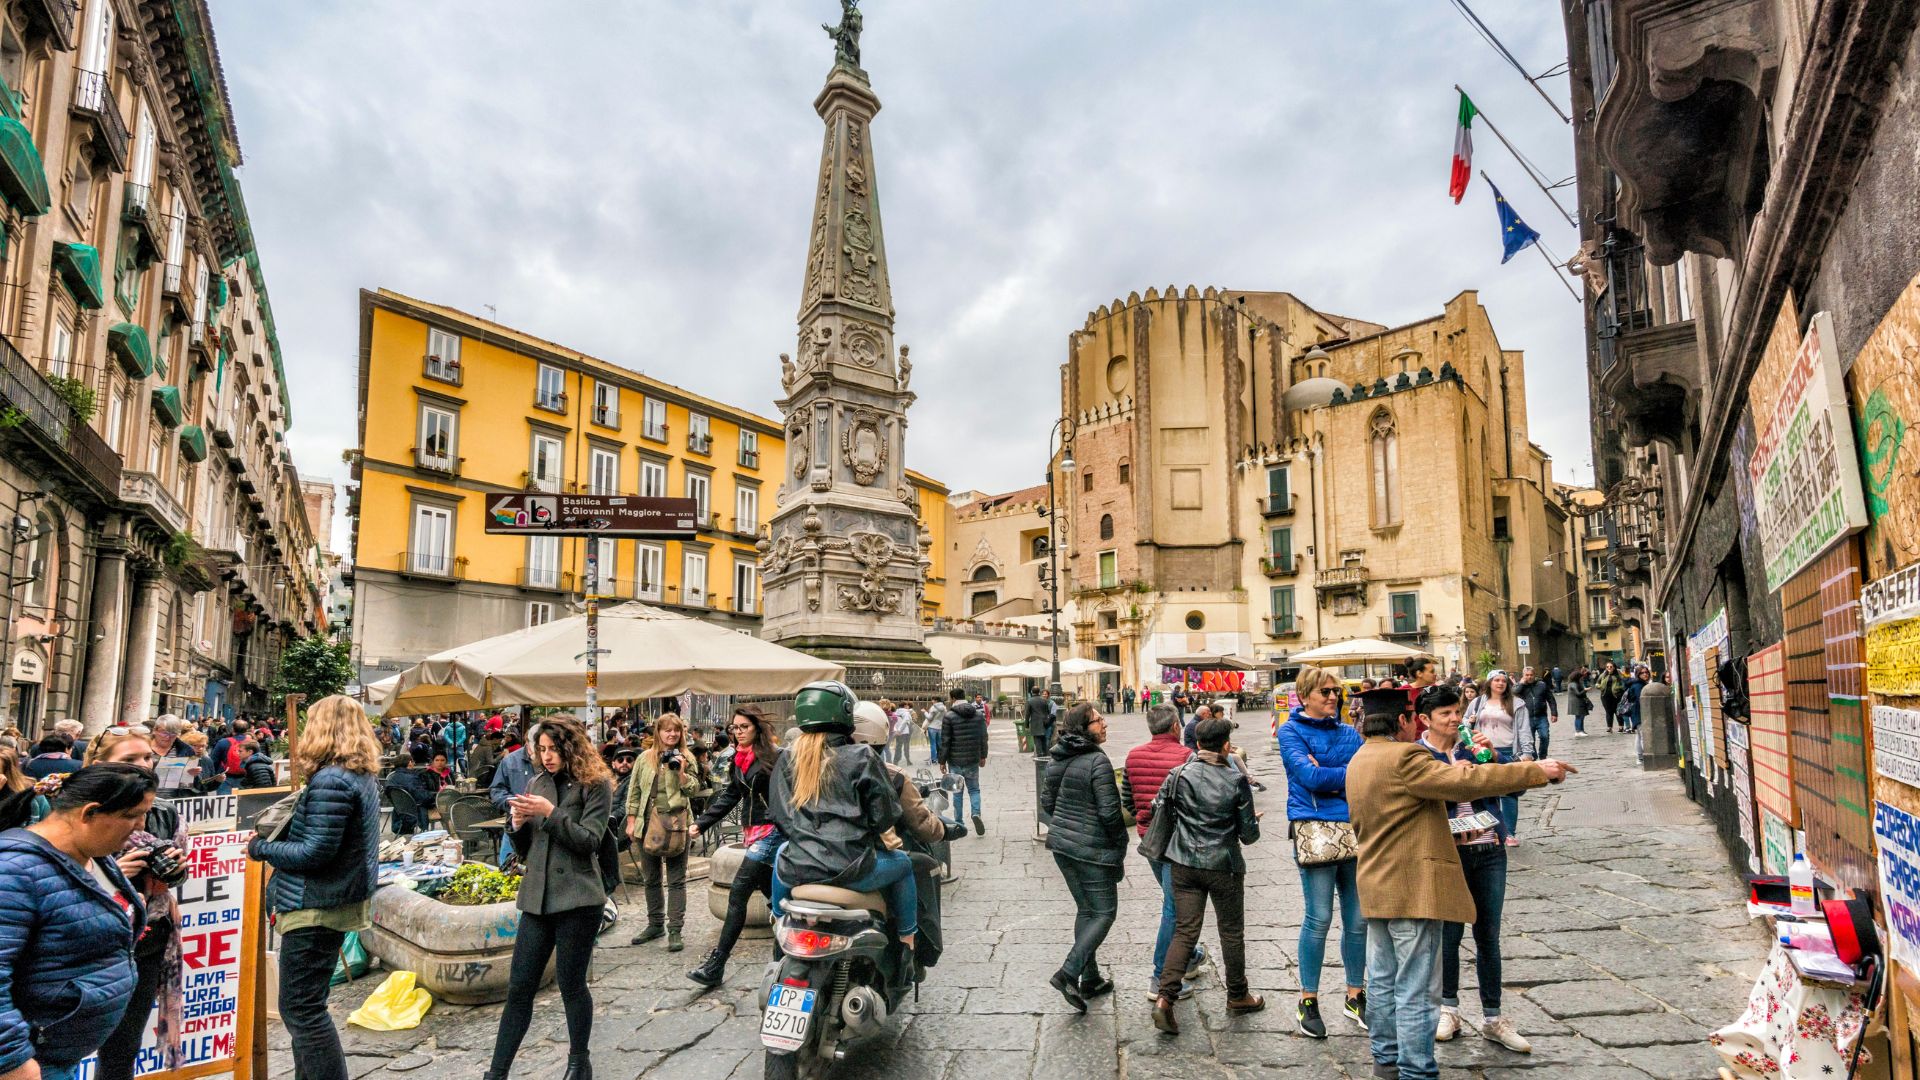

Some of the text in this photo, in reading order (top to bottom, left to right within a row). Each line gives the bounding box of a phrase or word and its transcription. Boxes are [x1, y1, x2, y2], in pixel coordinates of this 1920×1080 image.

[563, 497, 601, 506] Basilica
[563, 507, 614, 516] S.Giovanni
[618, 508, 661, 517] Maggiore
[779, 989, 798, 1008] CP
[765, 1010, 807, 1035] 35710
